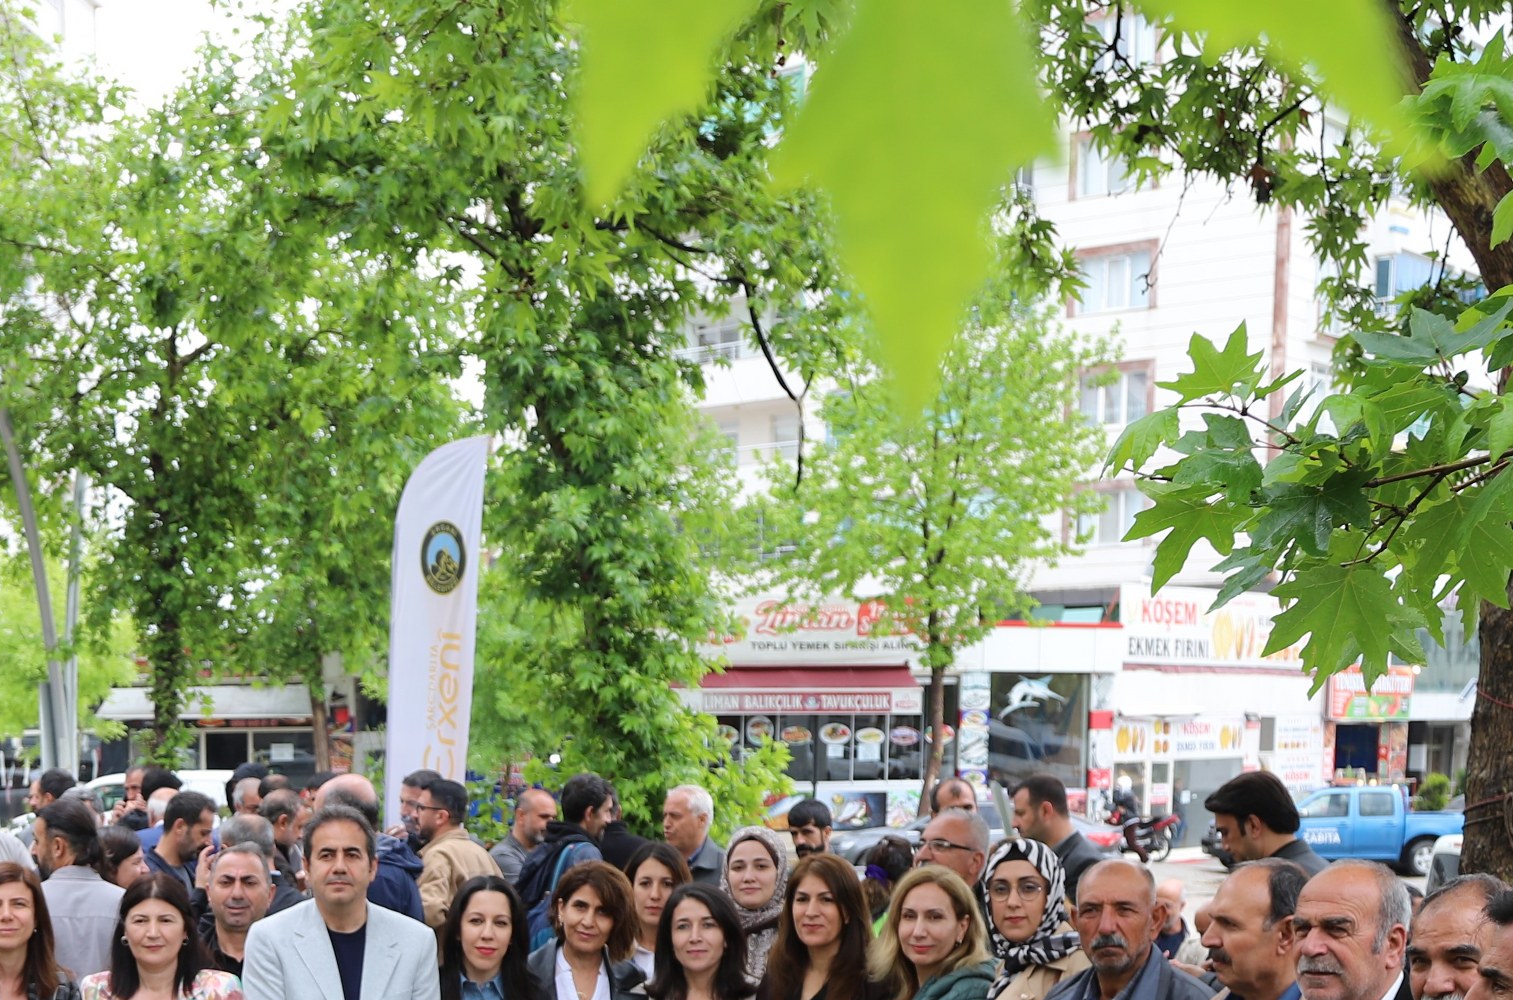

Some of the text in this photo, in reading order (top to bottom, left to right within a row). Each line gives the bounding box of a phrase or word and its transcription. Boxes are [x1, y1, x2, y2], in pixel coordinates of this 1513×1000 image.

[1141, 594, 1197, 631] KÖŞEM
[751, 640, 787, 651] TOPLU
[791, 640, 830, 651] YEMEK
[1128, 636, 1209, 659] EKMEK FIRINI
[821, 694, 890, 713] TAVUKÇULUK
